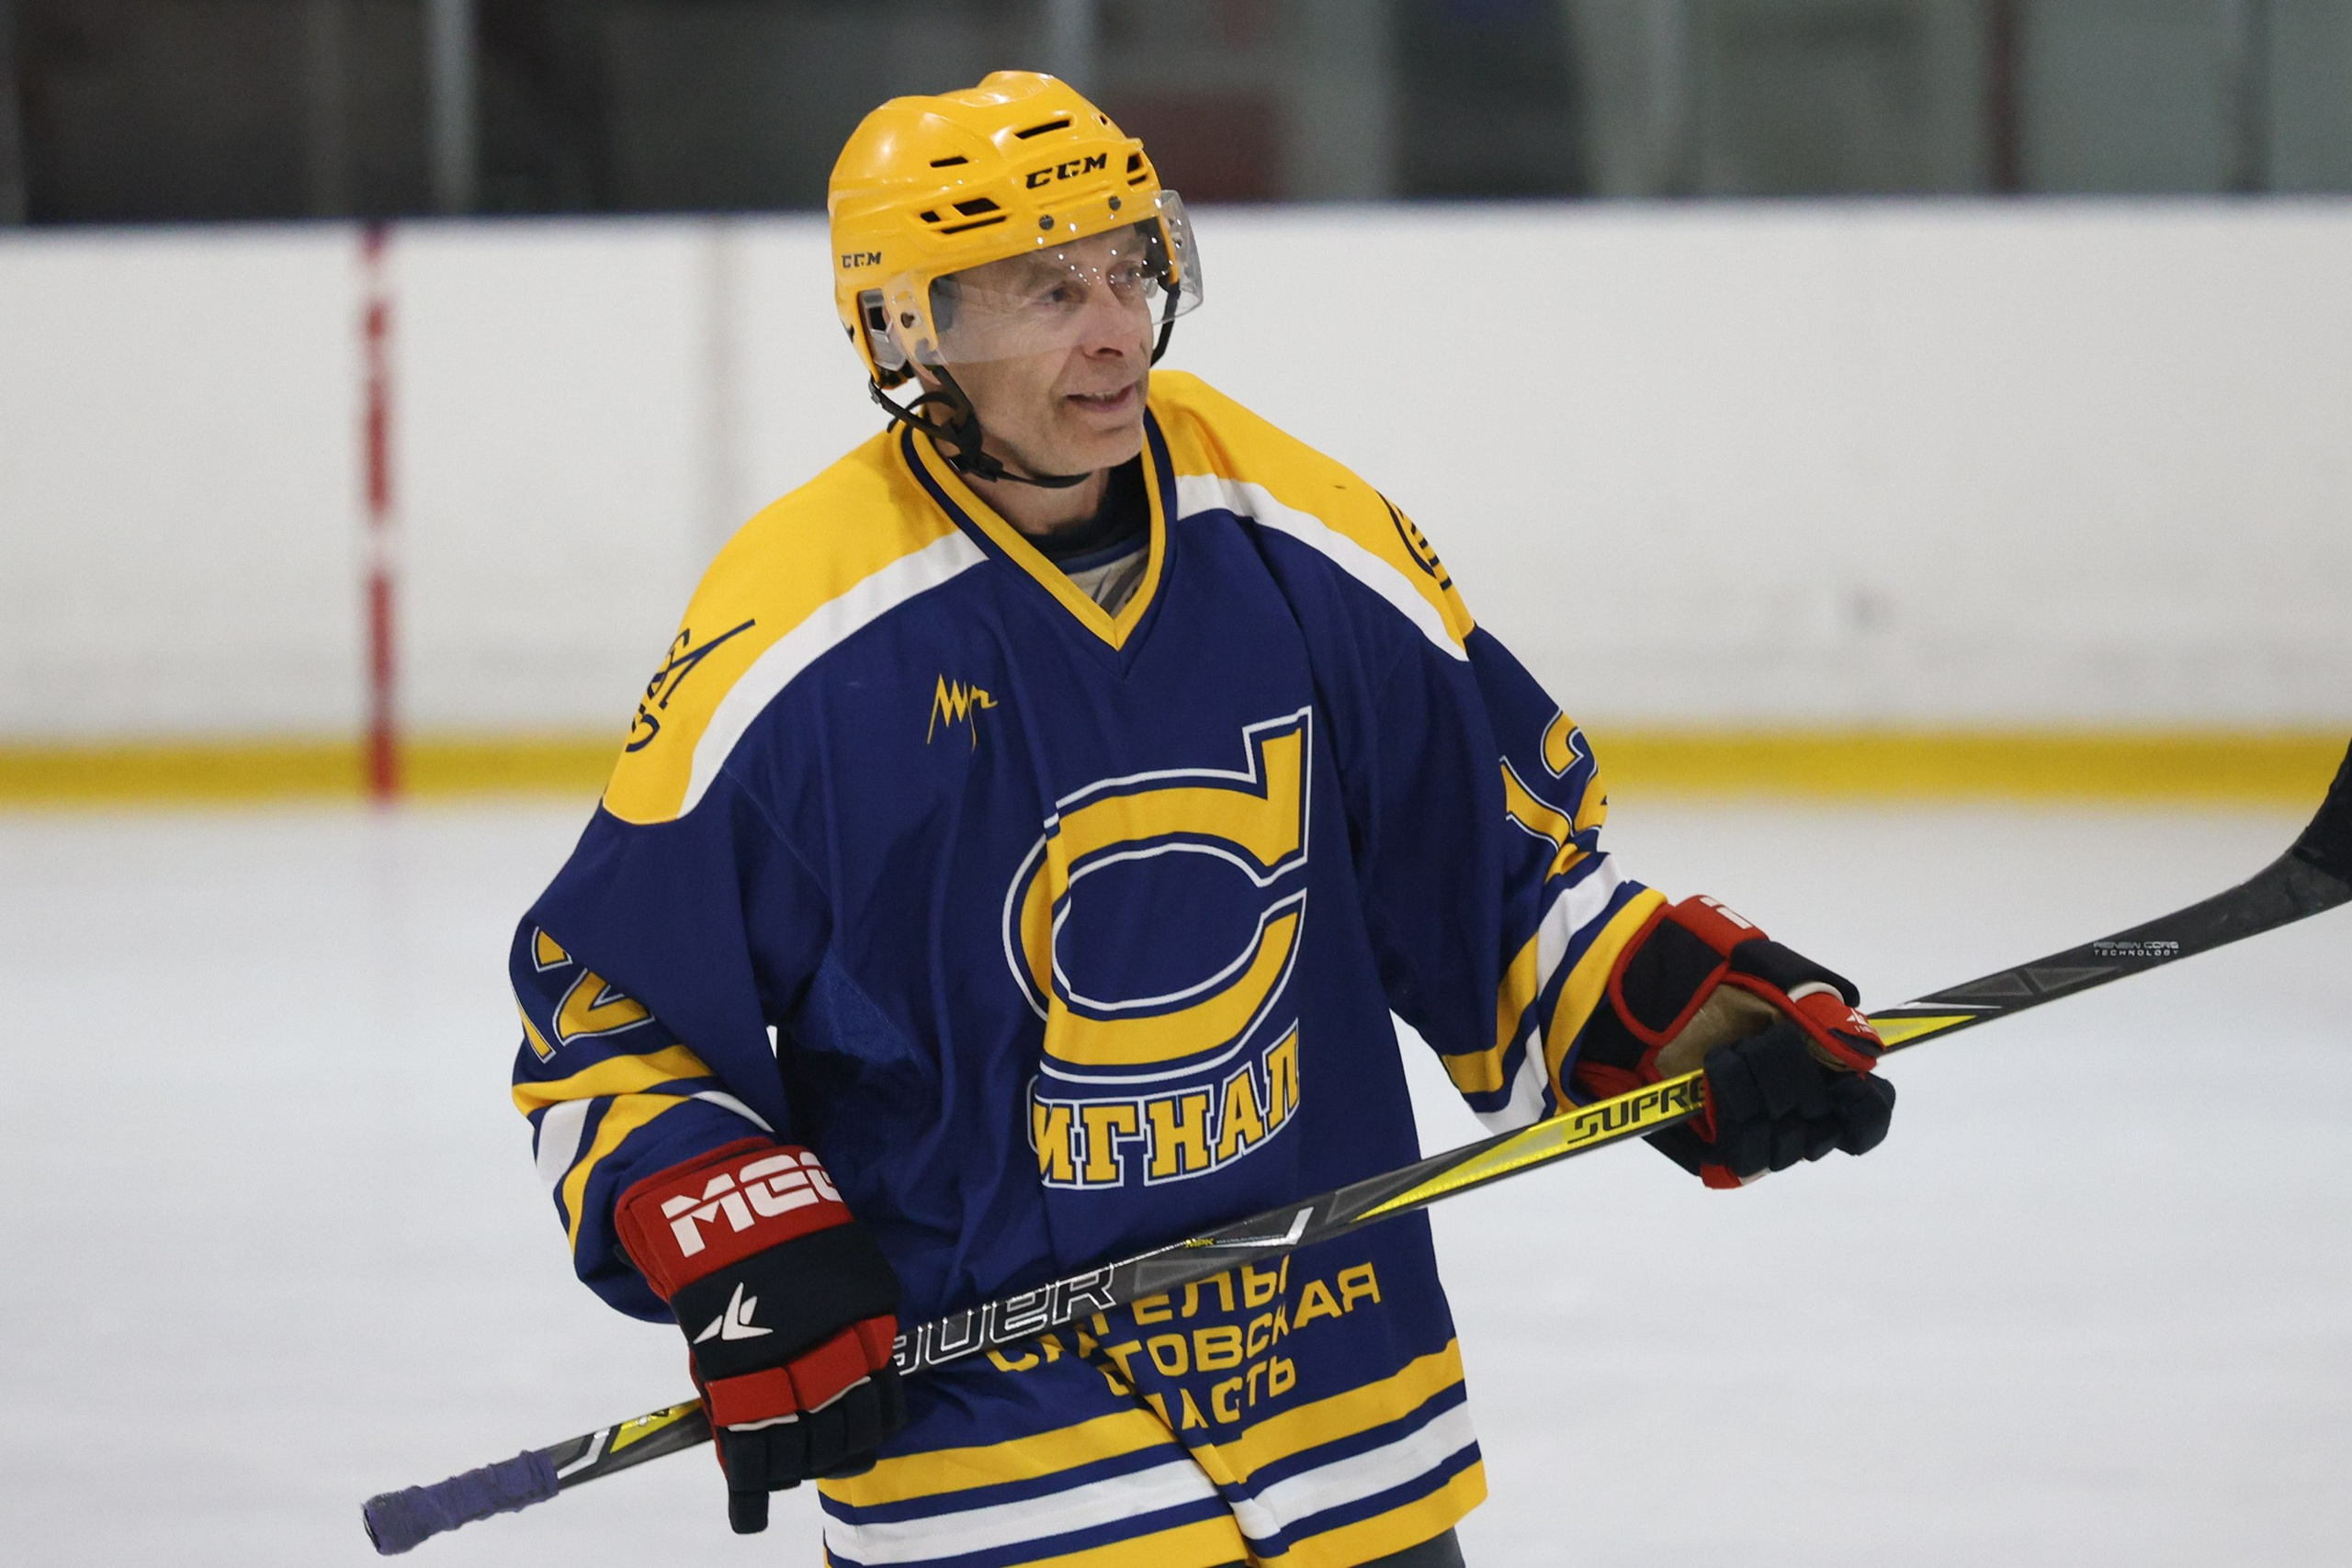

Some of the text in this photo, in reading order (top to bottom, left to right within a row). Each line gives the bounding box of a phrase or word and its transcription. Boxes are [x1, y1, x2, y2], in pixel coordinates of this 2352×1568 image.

[1025, 153, 1107, 189] CCM
[842, 251, 882, 268] CCM
[2094, 949, 2179, 957] TECHNOLOGY
[1027, 1017, 1300, 1190] ИГНАЛ
